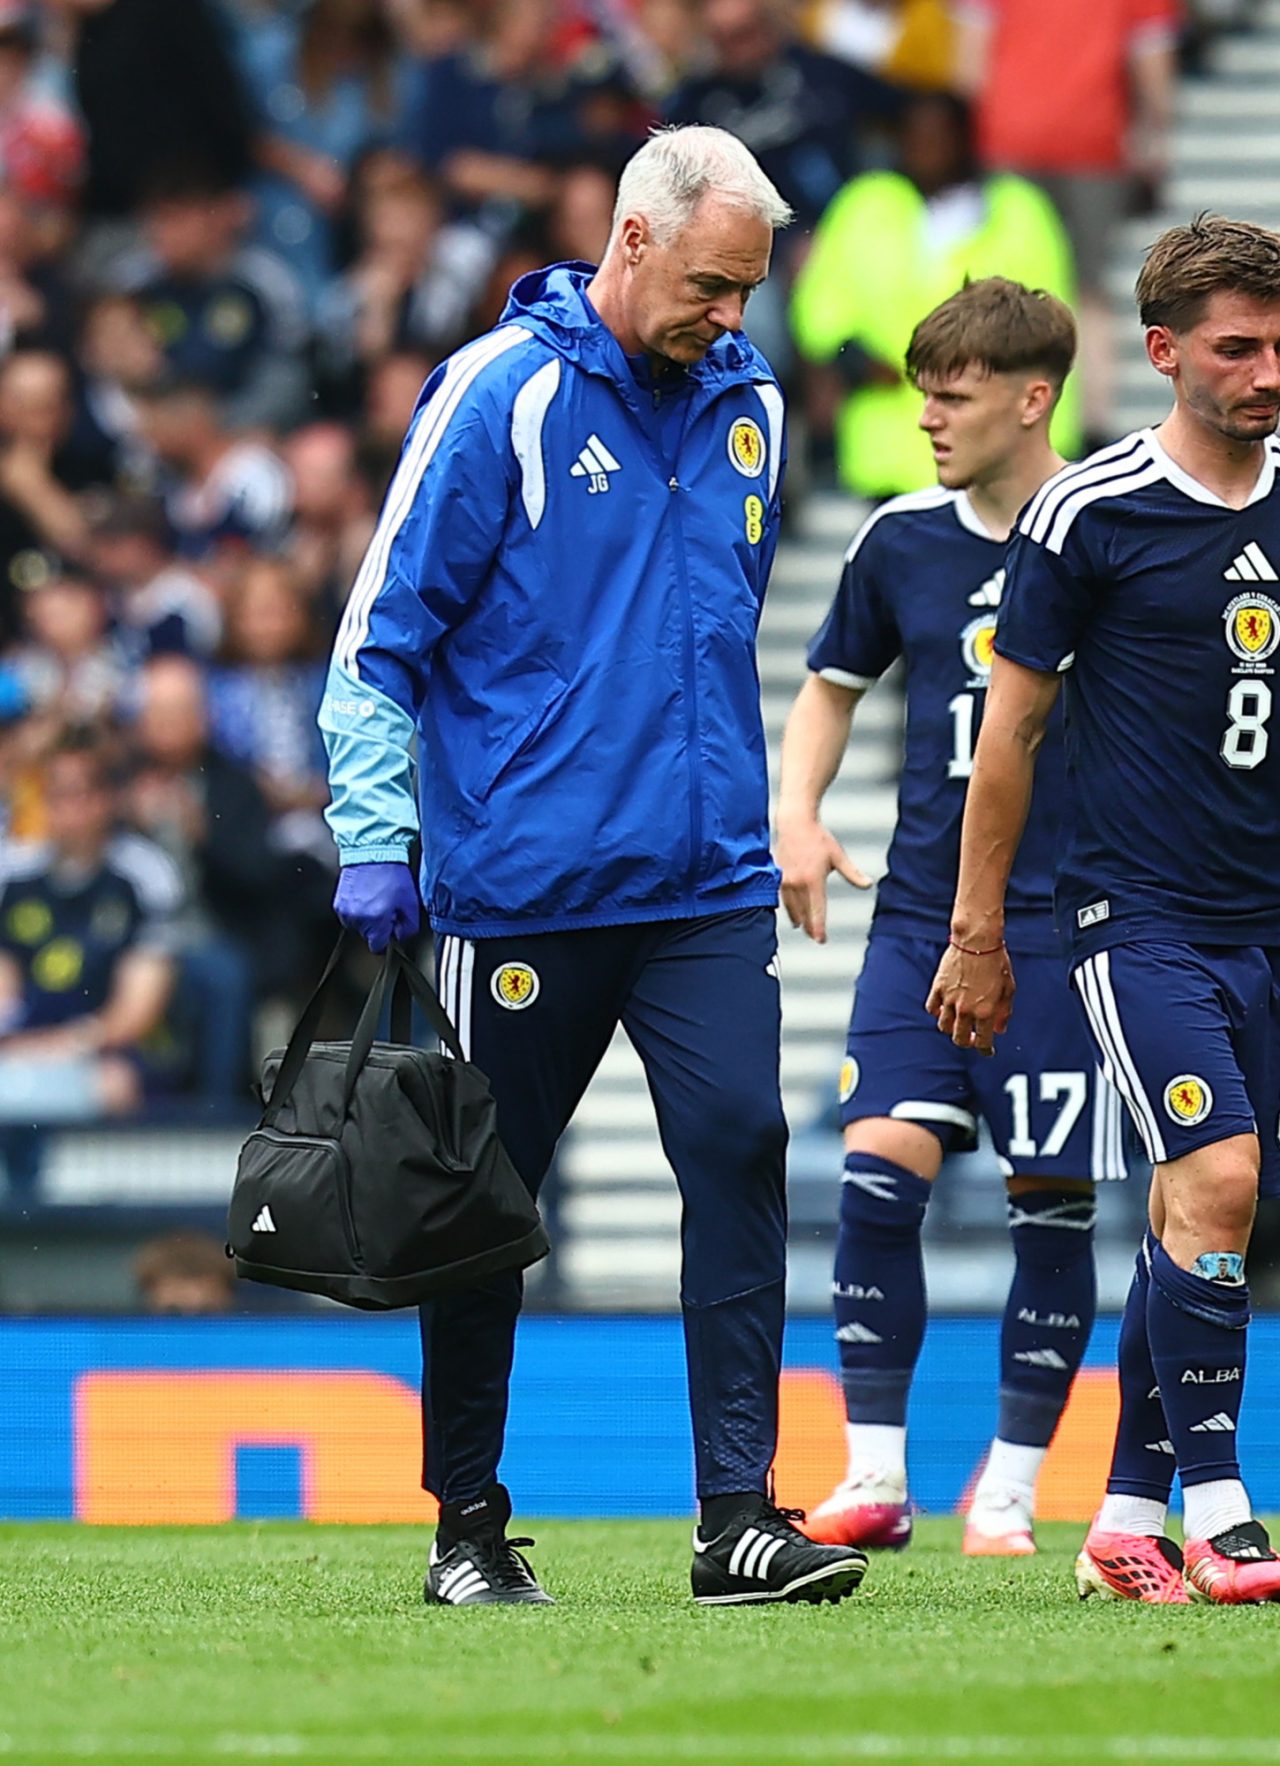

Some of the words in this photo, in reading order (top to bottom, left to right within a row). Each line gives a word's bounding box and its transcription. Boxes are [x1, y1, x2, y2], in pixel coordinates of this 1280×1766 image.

[587, 473, 609, 494] JG
[1220, 679, 1272, 769] 8
[948, 693, 974, 777] 1
[1004, 1072, 1087, 1157] 17
[833, 1281, 885, 1300] LBA
[1018, 1308, 1080, 1328] ALBA
[1181, 1367, 1241, 1384] ALBA
